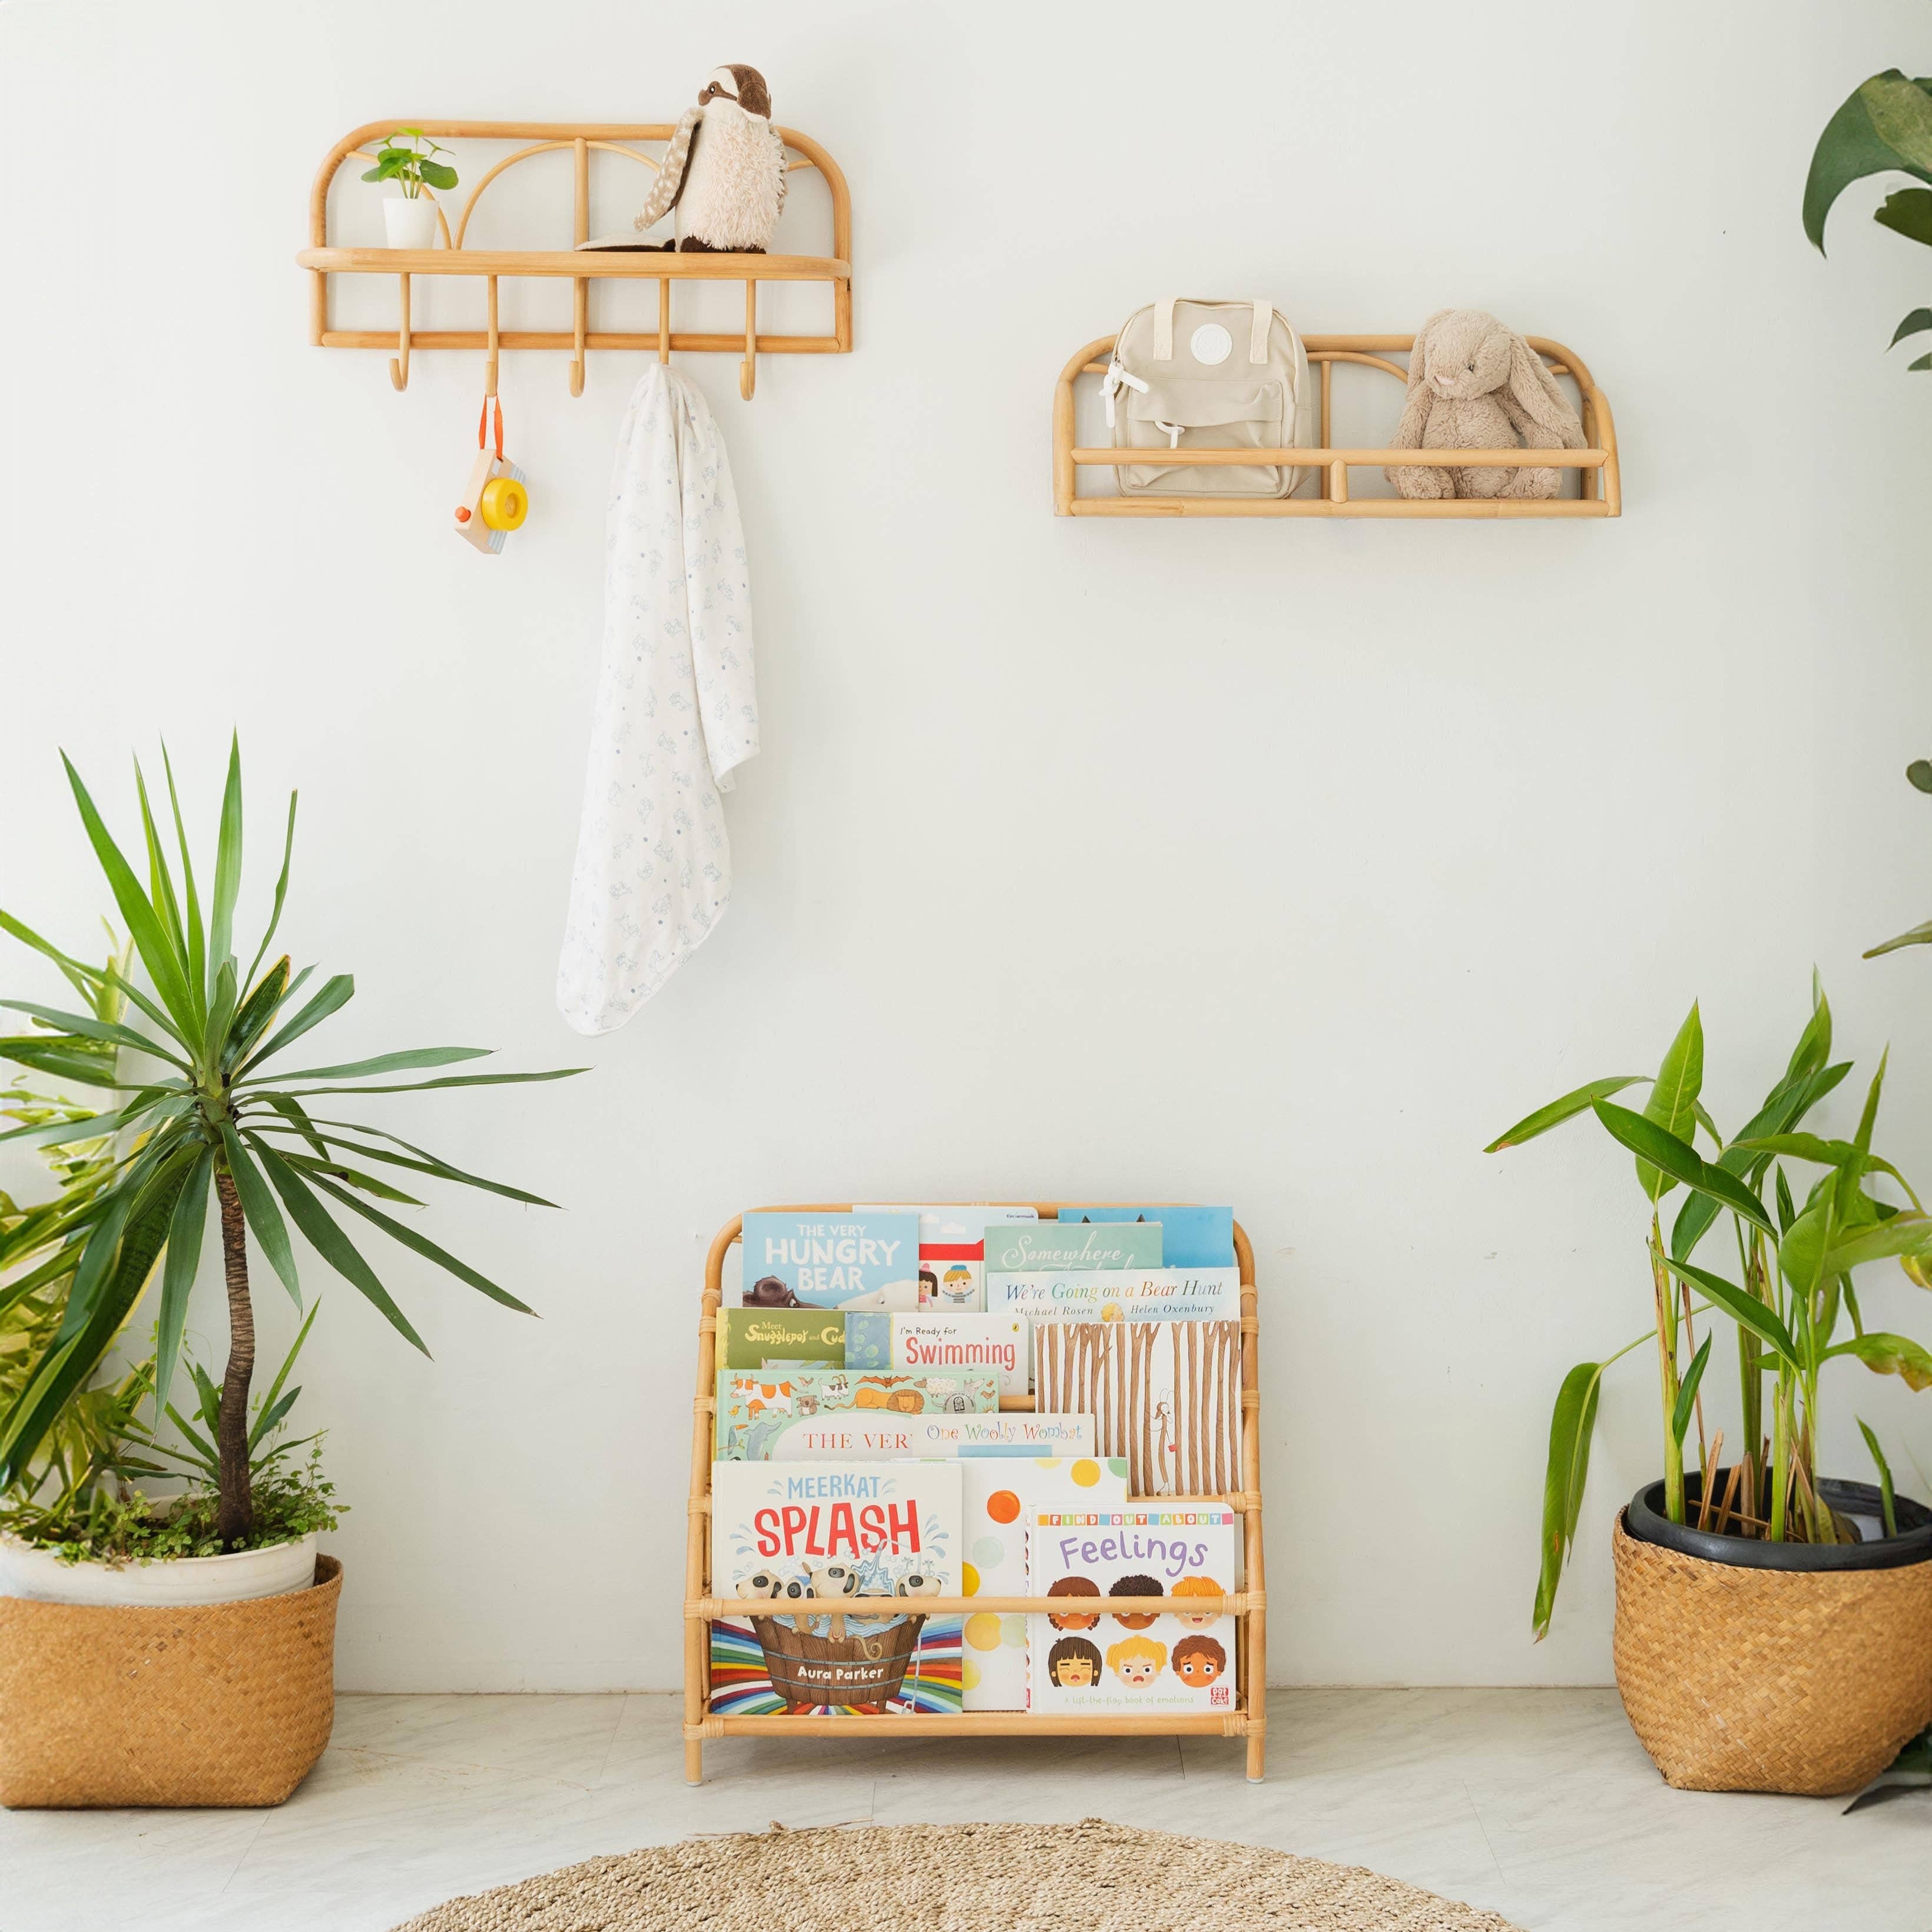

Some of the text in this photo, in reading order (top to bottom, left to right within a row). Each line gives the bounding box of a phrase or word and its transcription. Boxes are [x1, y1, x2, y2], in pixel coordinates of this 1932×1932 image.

[797, 1224, 867, 1237] THE VERY
[765, 1237, 901, 1266] HUNGRY
[1002, 1231, 1123, 1268] Somewhere
[798, 1267, 866, 1291] BEAR
[1006, 1280, 1222, 1303] We're Going on a Bear Hunt
[1015, 1306, 1093, 1317] Michael Rosen
[1131, 1304, 1214, 1315] Helen Oxenbury
[745, 1324, 809, 1346] Snugglepot
[761, 1321, 782, 1330] Meet
[900, 1327, 912, 1335] I'm
[916, 1327, 940, 1337] Ready
[906, 1337, 1016, 1371] Swimming
[803, 1433, 913, 1449] THE VER
[927, 1421, 1082, 1442] One Woolly Wombat
[788, 1473, 881, 1499] MEERKAT
[754, 1500, 920, 1559] SPLASH
[1052, 1514, 1220, 1525] FIND OUT ABOUT
[1060, 1530, 1208, 1577] Feelings
[797, 1666, 884, 1680] Aura Parker
[1072, 1695, 1122, 1705] lift-the-flap
[1125, 1695, 1144, 1704] book
[1157, 1695, 1194, 1704] emotions
